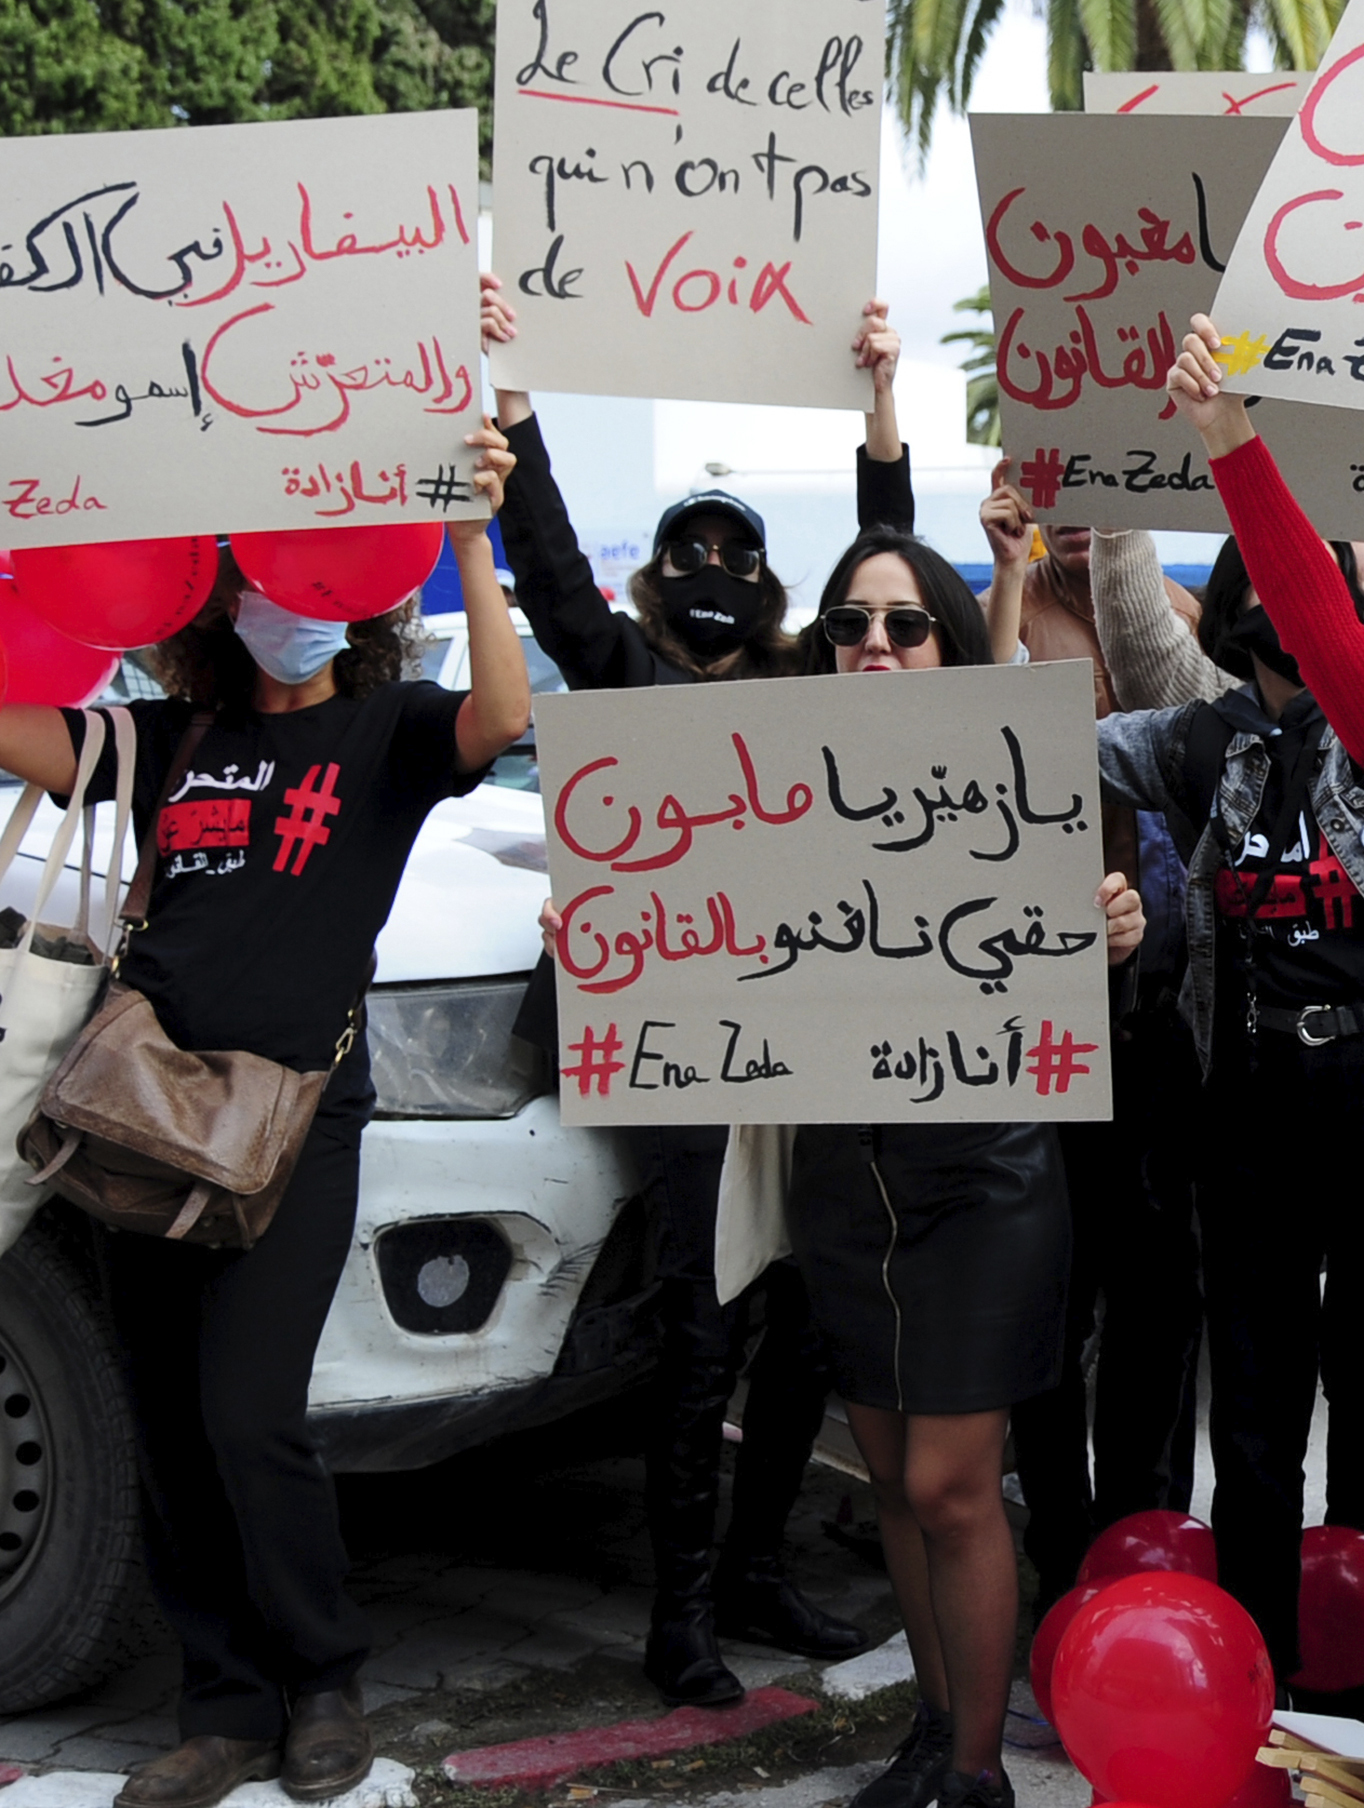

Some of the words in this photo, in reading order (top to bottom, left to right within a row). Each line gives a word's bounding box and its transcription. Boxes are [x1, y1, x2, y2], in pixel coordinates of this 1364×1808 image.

[528, 147, 608, 233] qui
[793, 164, 872, 243] pas
[518, 234, 584, 299] de
